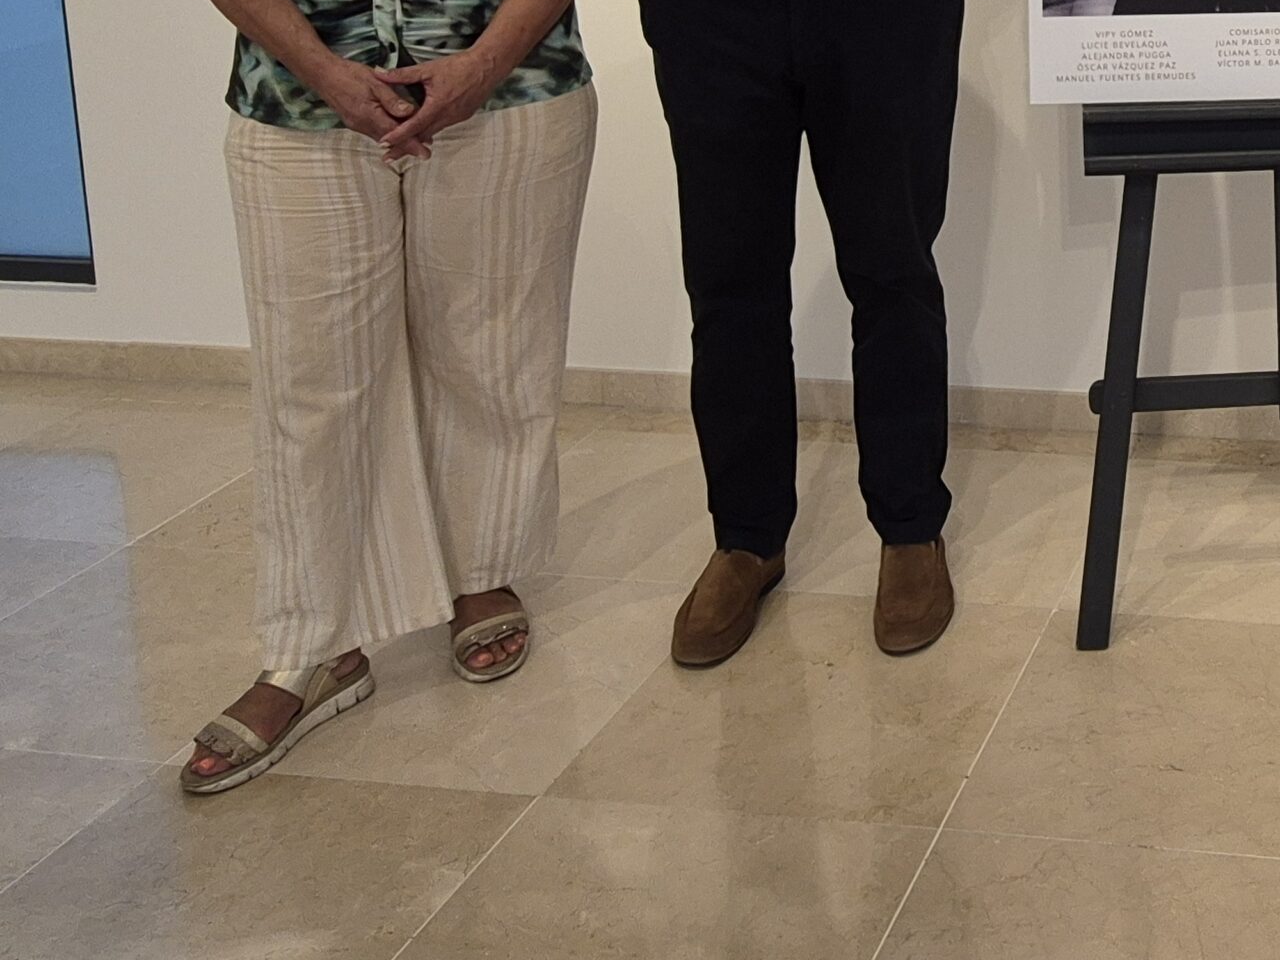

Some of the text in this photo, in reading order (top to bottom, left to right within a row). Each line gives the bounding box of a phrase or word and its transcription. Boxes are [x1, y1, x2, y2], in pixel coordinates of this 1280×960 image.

[1095, 29, 1154, 39] VIPY GÓMEZ
[1081, 40, 1169, 50] LUCIE BEVELAQUA
[1215, 40, 1238, 49] JUAN
[1242, 39, 1272, 47] PABLO
[1081, 52, 1135, 62] ALEJANDRA
[1218, 49, 1250, 58] ELIANA
[1077, 60, 1177, 72] ÓSCAR VÁZQUEZ PAZ
[1217, 58, 1251, 68] VÍCTOR
[1056, 72, 1197, 83] MANUEL FUENTES BERMUDES
